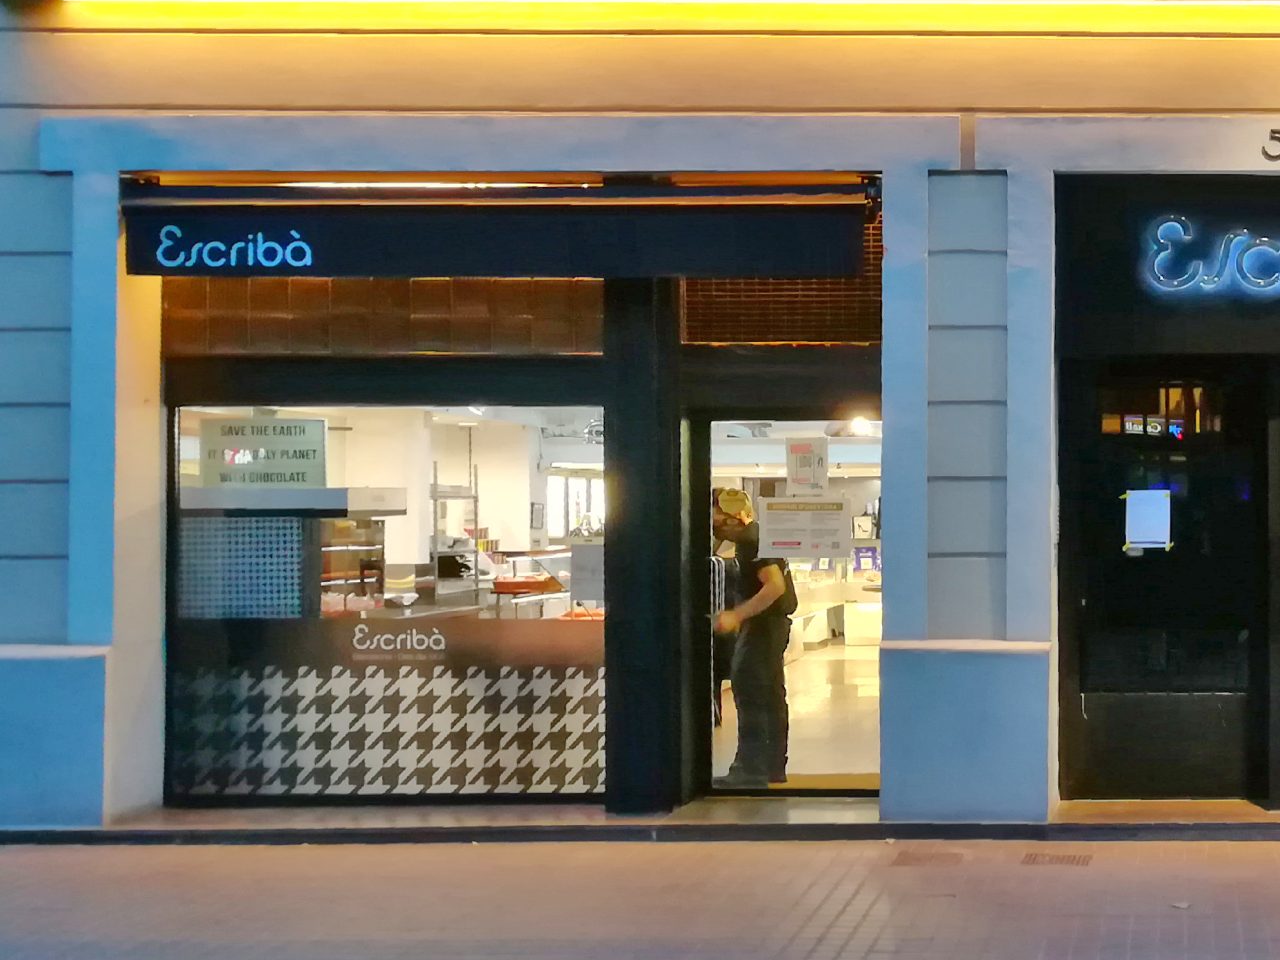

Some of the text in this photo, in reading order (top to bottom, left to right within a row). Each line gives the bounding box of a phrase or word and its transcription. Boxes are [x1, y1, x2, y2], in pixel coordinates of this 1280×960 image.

[155, 224, 312, 268] Escribà
[220, 424, 306, 437] SAVE THE EARTH
[280, 449, 317, 460] PLANET
[249, 471, 307, 483] CHOCOLATE
[352, 623, 446, 650] Escribà
